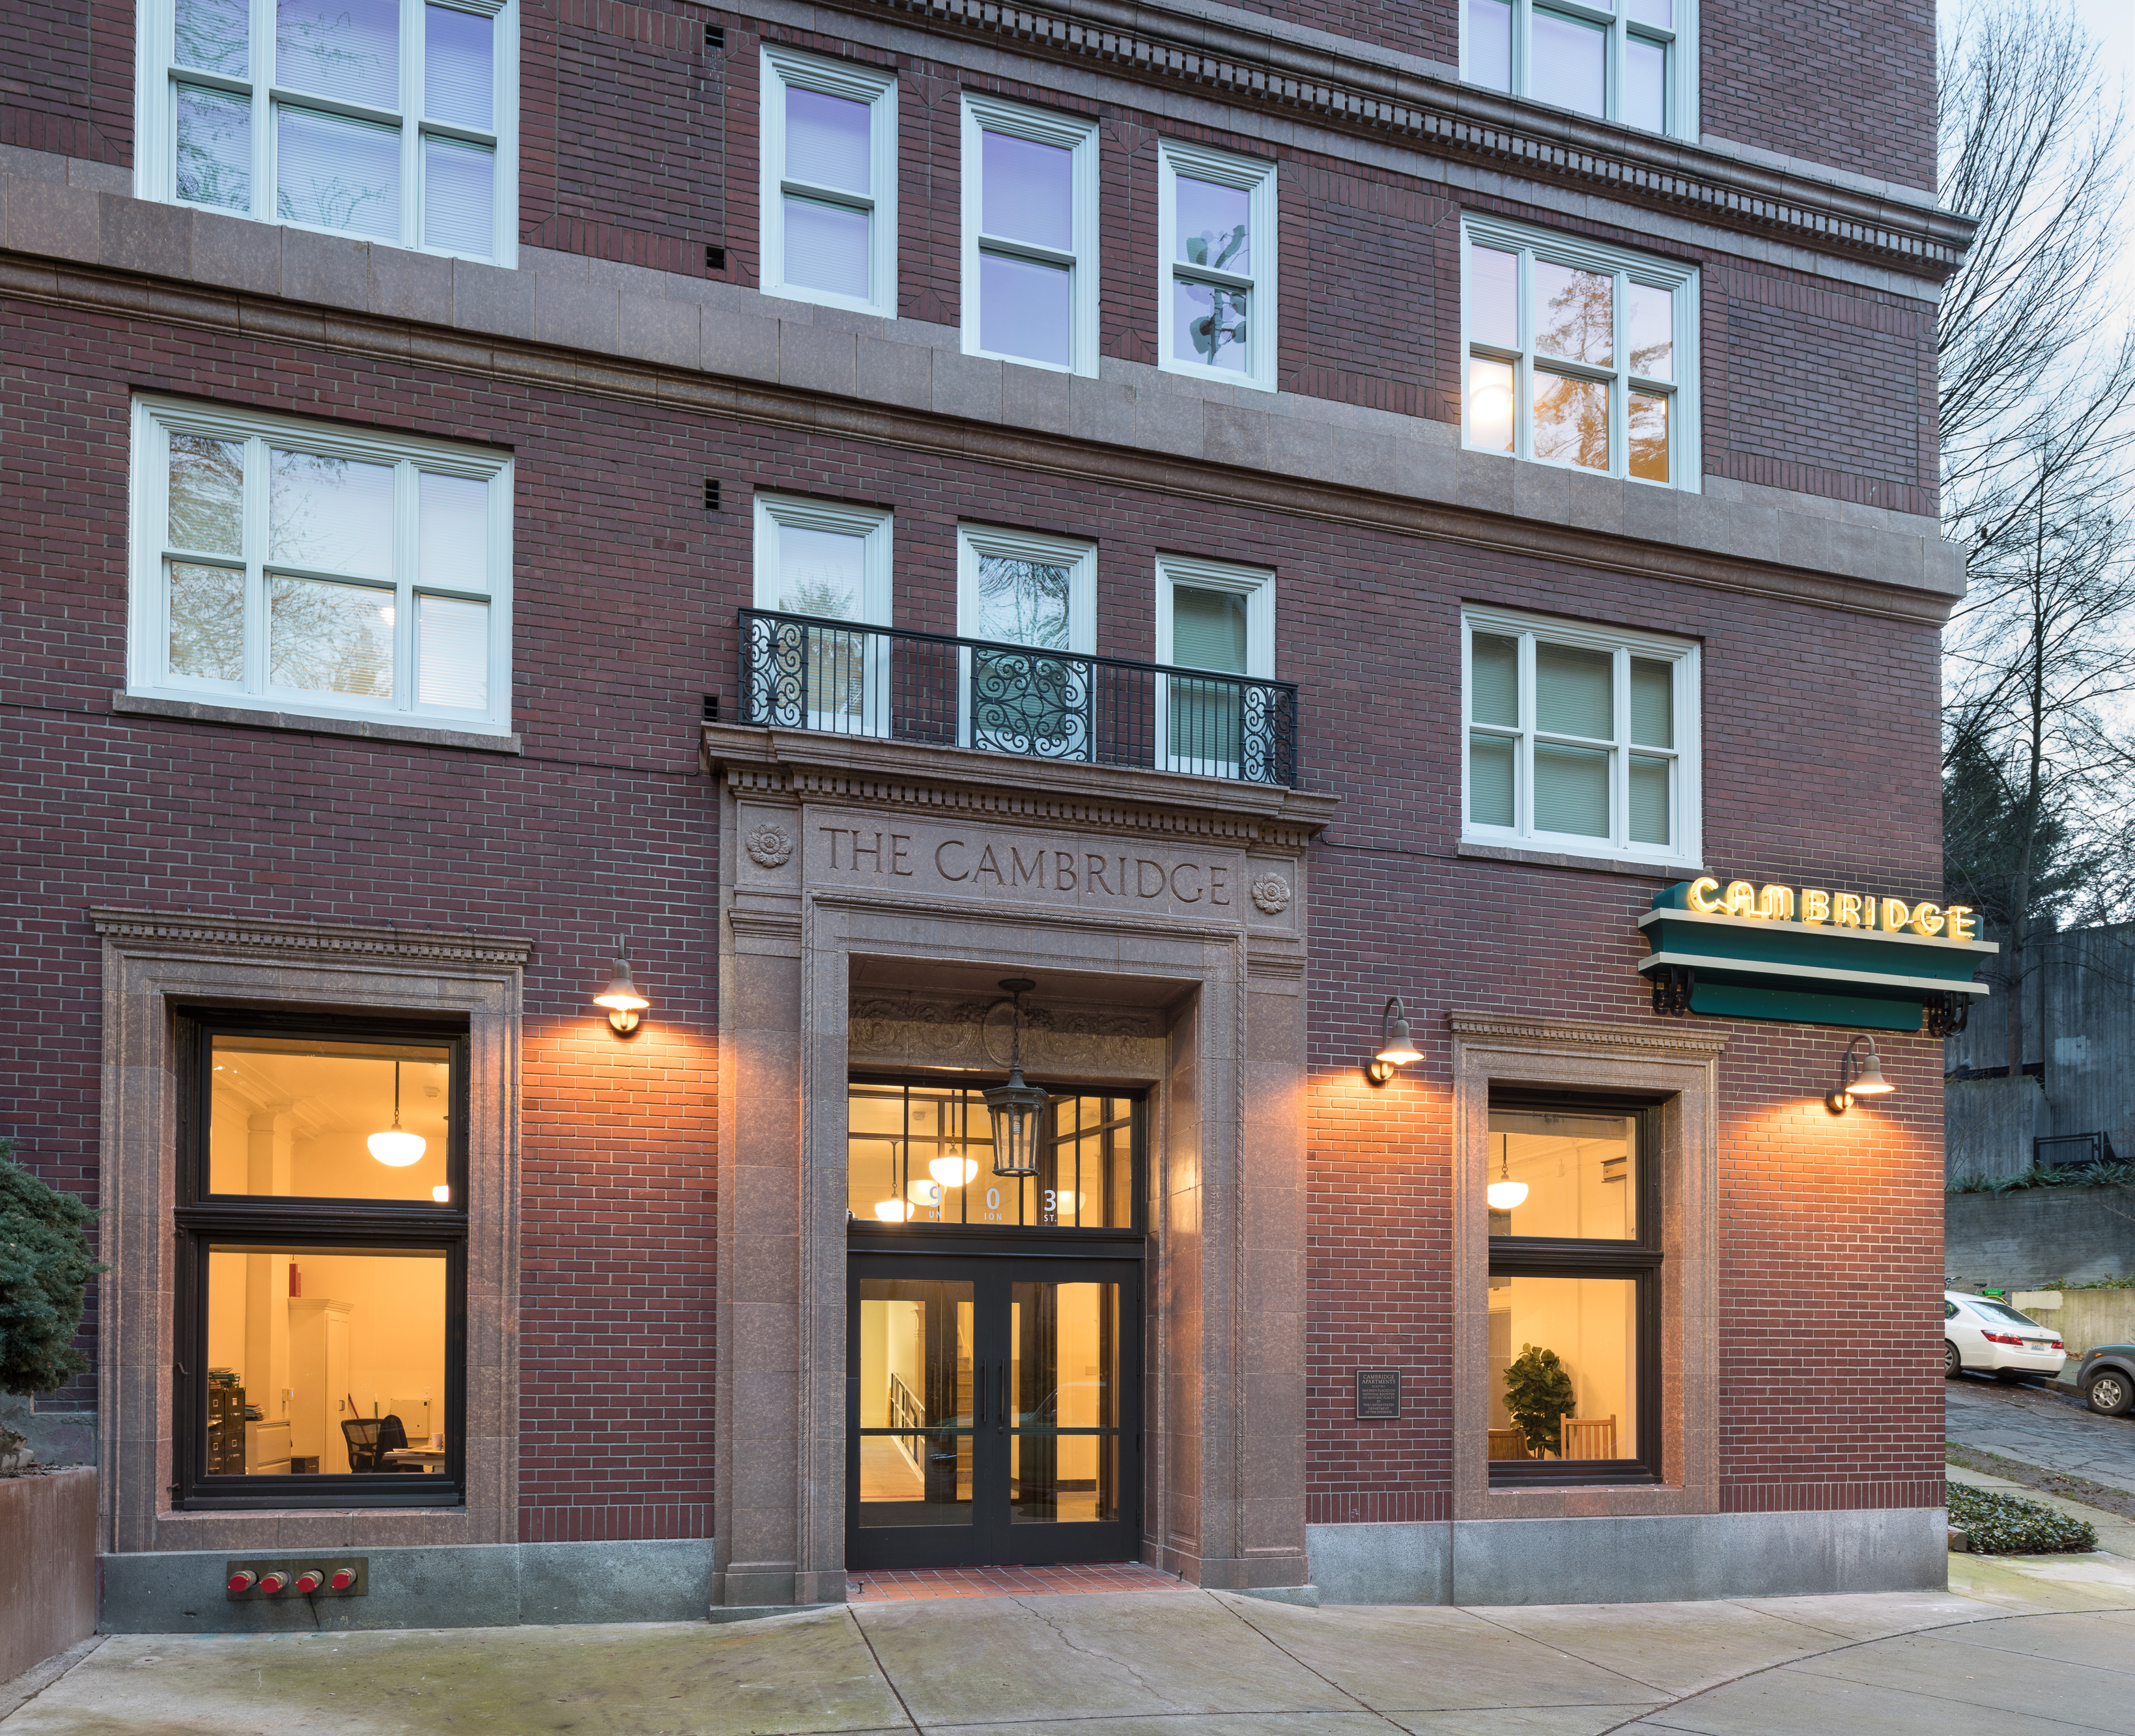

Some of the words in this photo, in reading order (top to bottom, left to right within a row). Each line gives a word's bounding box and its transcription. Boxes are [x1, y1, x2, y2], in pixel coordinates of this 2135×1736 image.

[818, 826, 913, 876] THE
[934, 839, 1231, 906] CAMBRIDGE
[1690, 877, 1977, 939] CAMBRIDGE
